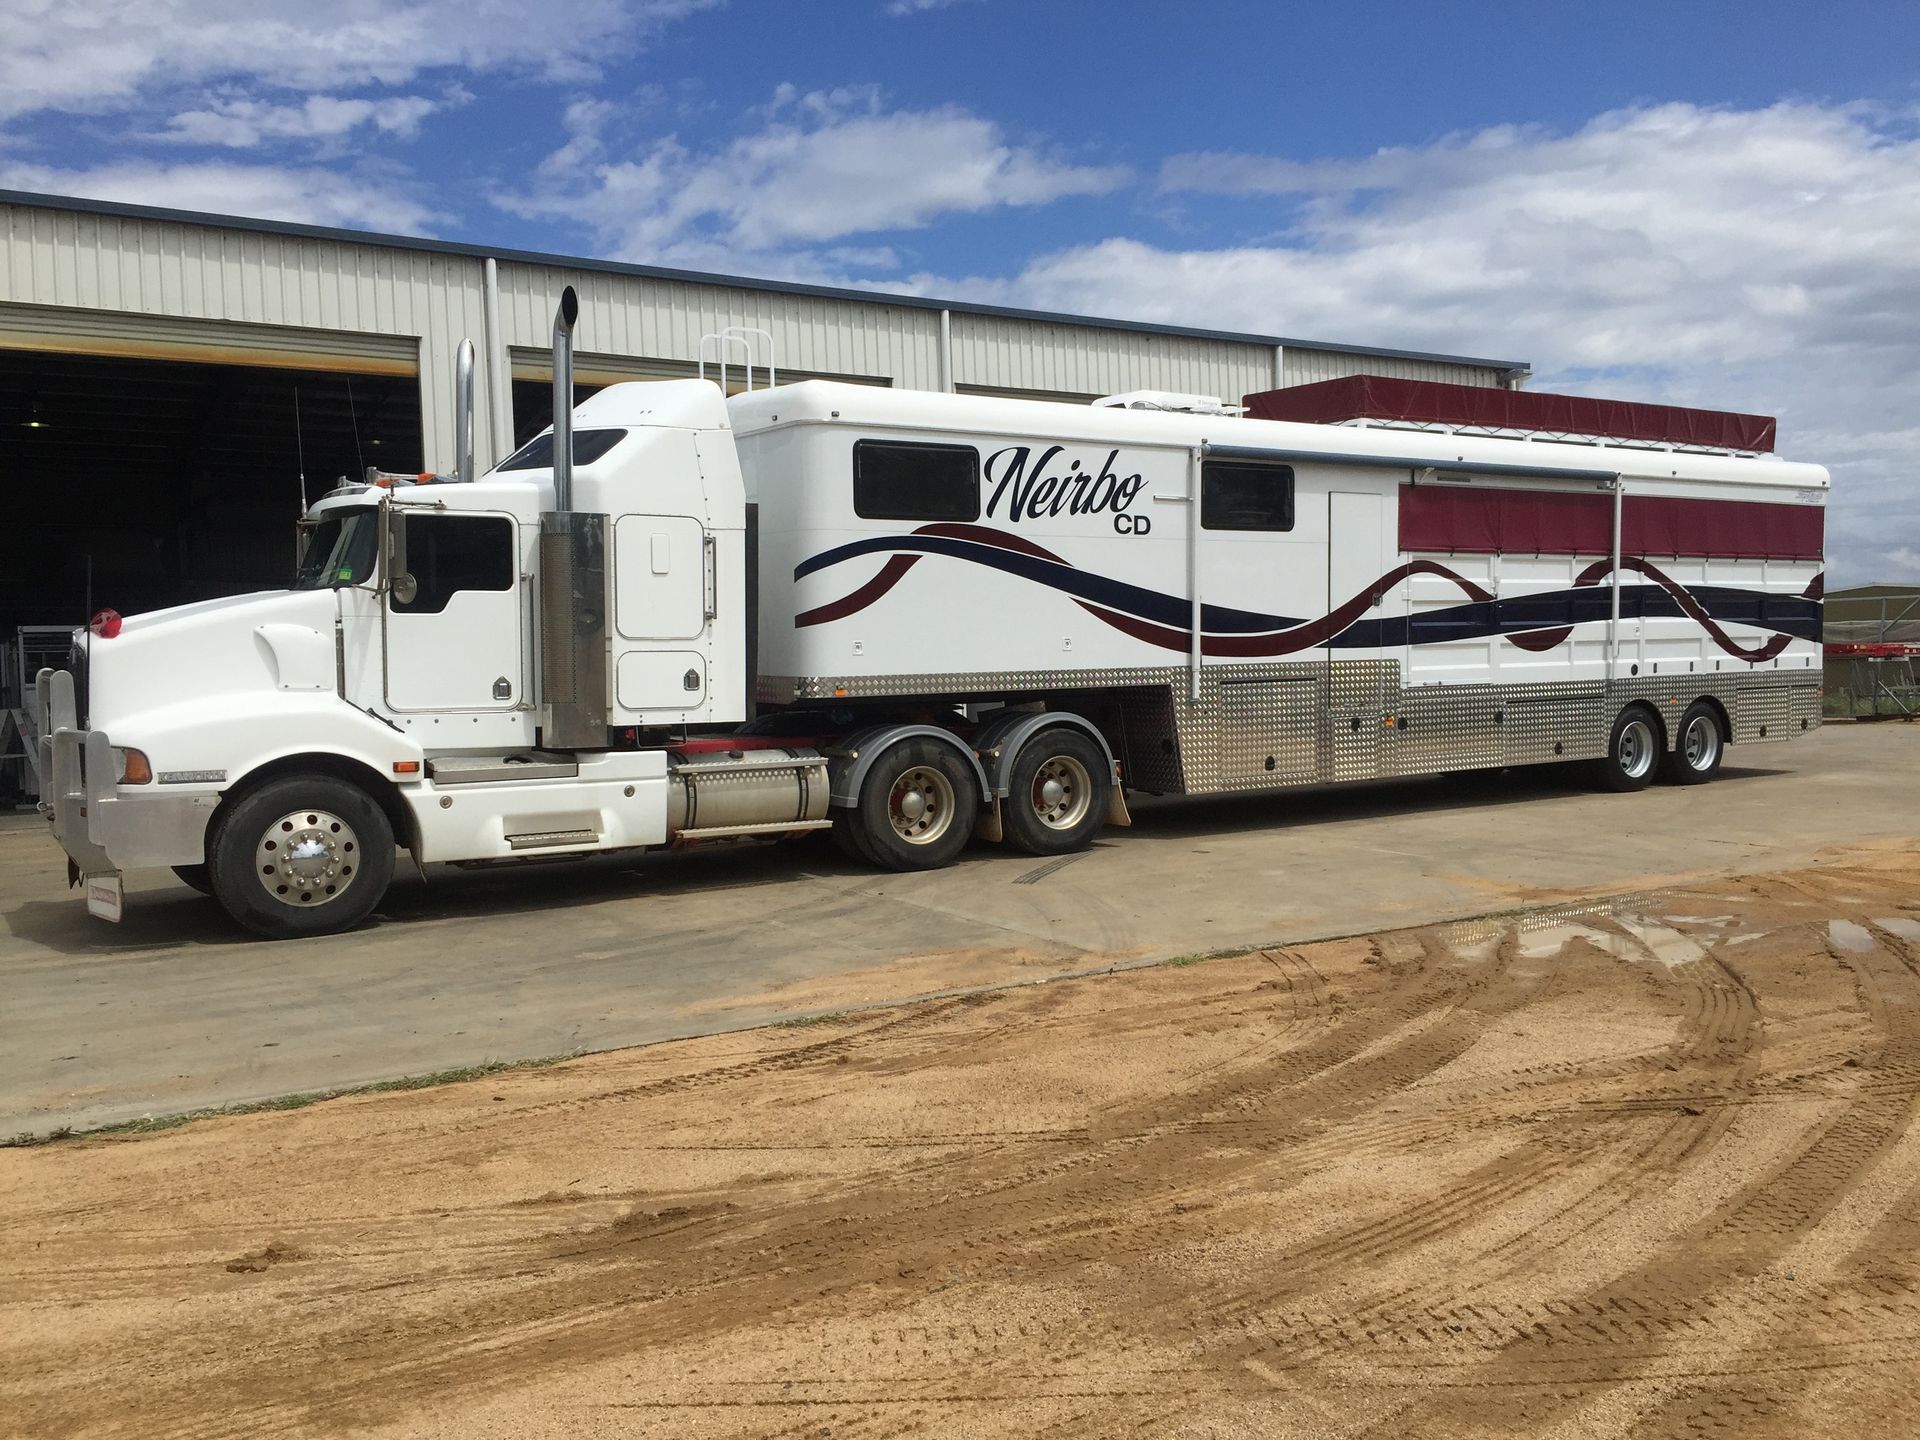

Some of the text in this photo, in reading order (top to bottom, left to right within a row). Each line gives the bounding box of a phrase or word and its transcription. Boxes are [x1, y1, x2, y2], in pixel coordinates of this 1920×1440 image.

[984, 445, 1149, 523] Neirbo
[1114, 514, 1151, 535] CD
[158, 770, 225, 784] KENWORTH
